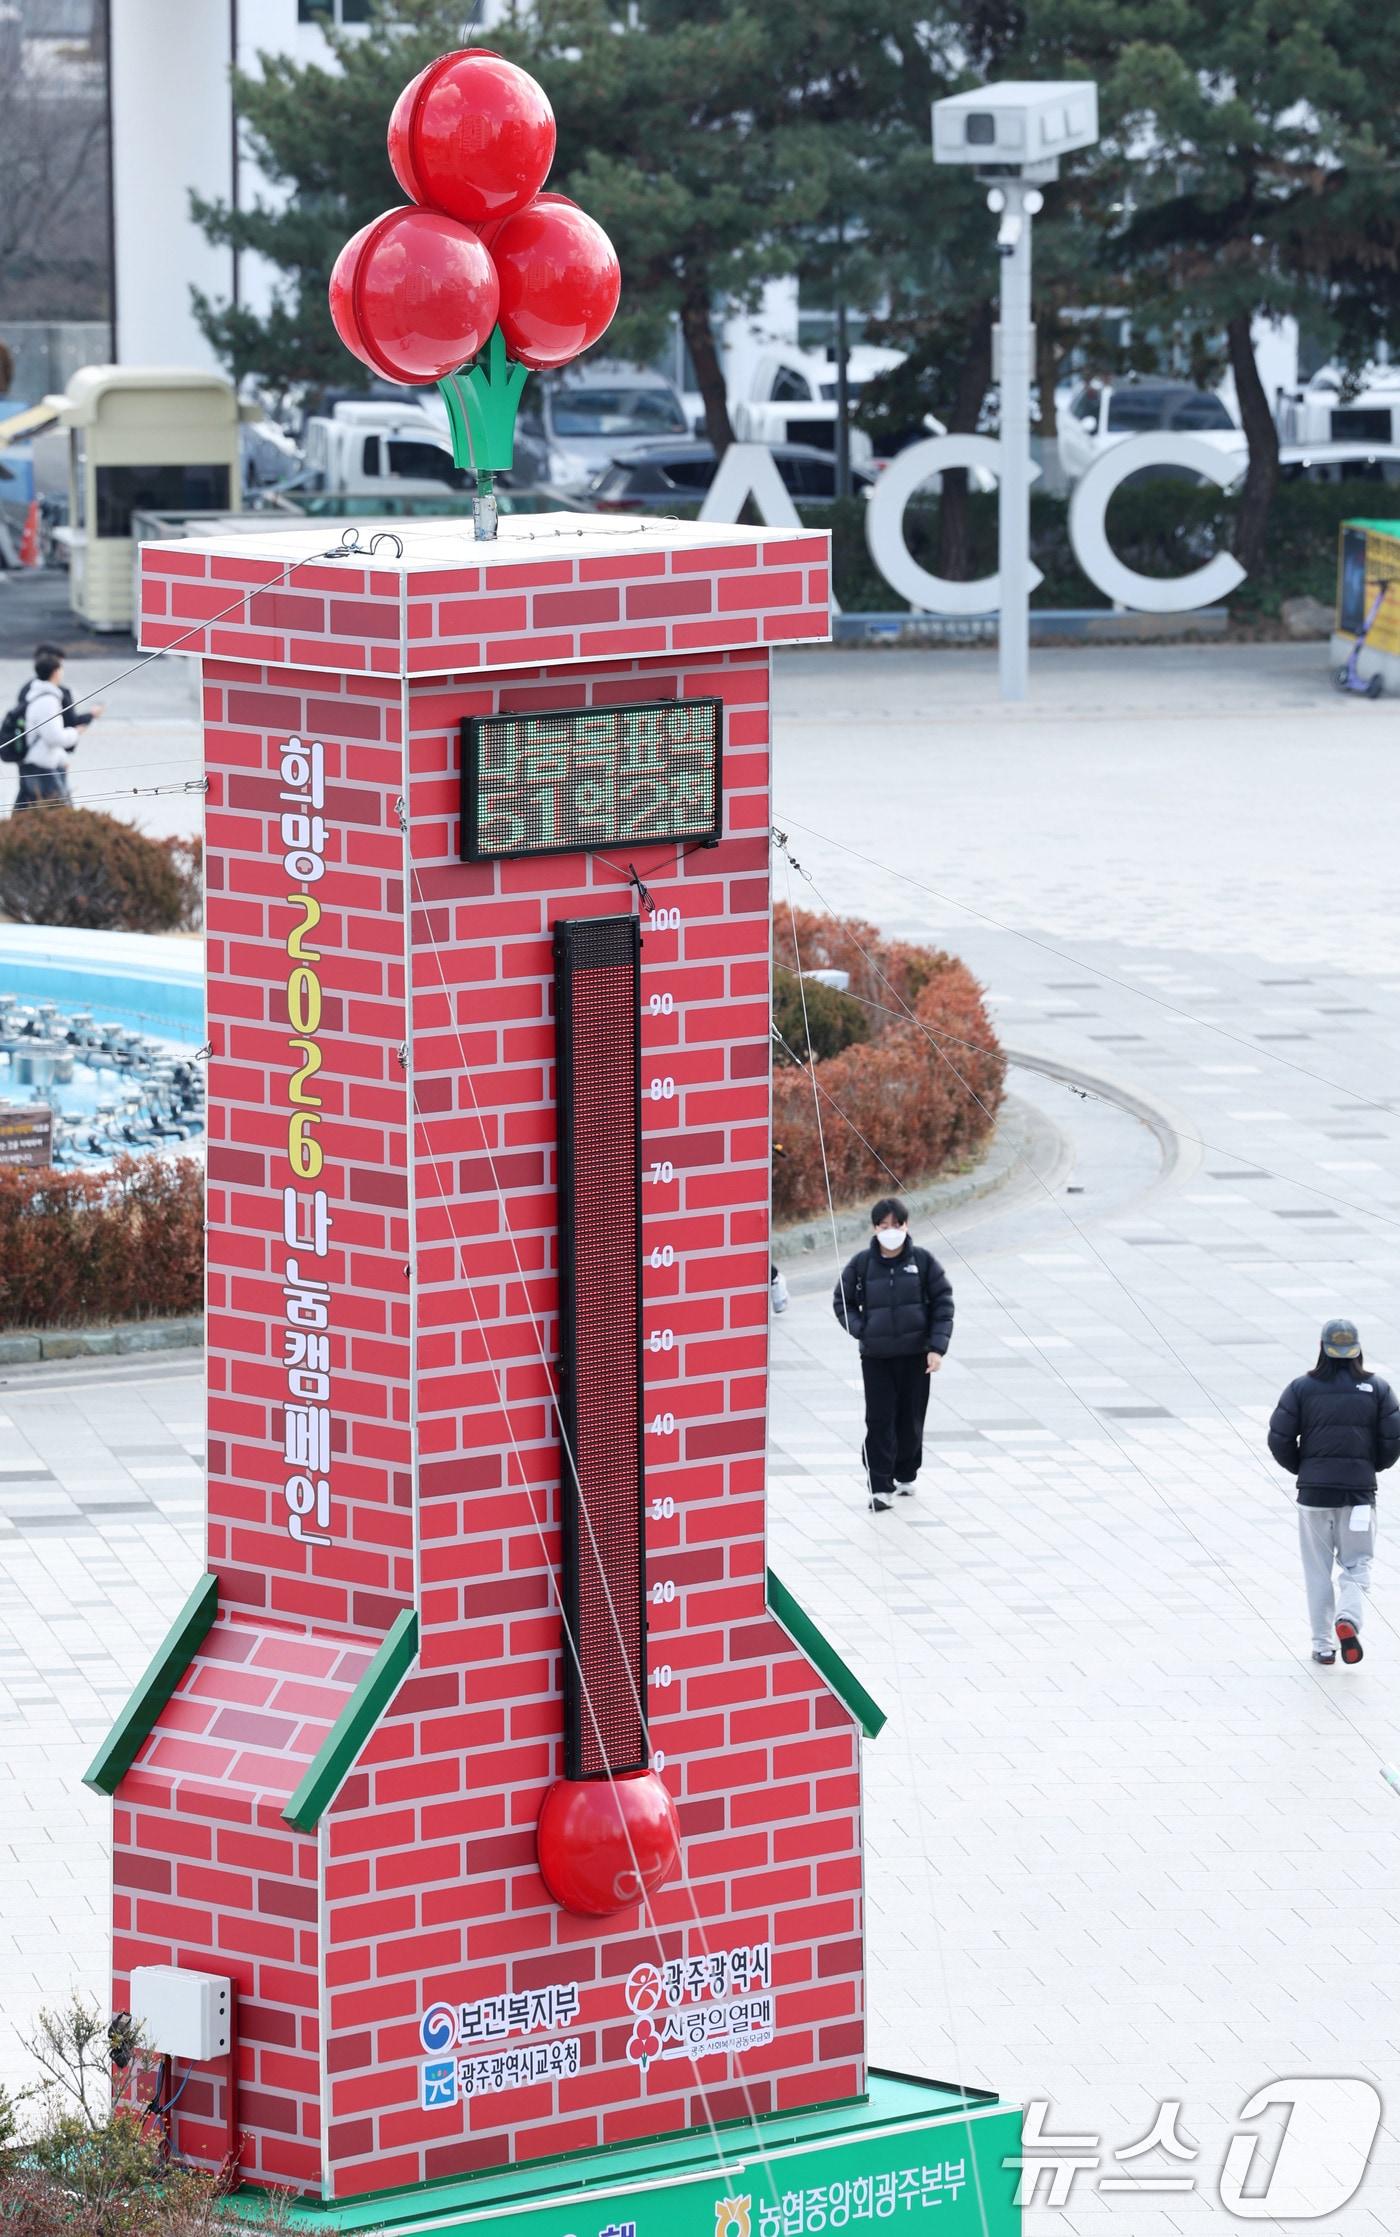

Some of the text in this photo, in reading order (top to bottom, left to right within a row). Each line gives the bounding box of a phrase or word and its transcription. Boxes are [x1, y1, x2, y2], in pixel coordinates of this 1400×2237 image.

[477, 705, 717, 787] 나눔목표액
[477, 768, 717, 854] 51억2천
[648, 907, 681, 931] 100
[650, 992, 674, 1016] 90
[650, 1076, 675, 1100] 80
[650, 1161, 673, 1185] 70
[650, 1244, 674, 1269] 60
[649, 1328, 674, 1353] 50
[650, 1412, 675, 1436] 40
[651, 1496, 675, 1521] 30
[652, 1580, 676, 1605] 20
[653, 1664, 672, 1689] 10
[653, 1749, 666, 1773] 0
[665, 1946, 770, 2003] 광주광역시
[461, 1986, 578, 2040] 보건복지부
[664, 1999, 771, 2044] 사랑의열매
[461, 2042, 578, 2094] 광주광역시교육청
[758, 2157, 967, 2237] 농협중앙회광주본부
